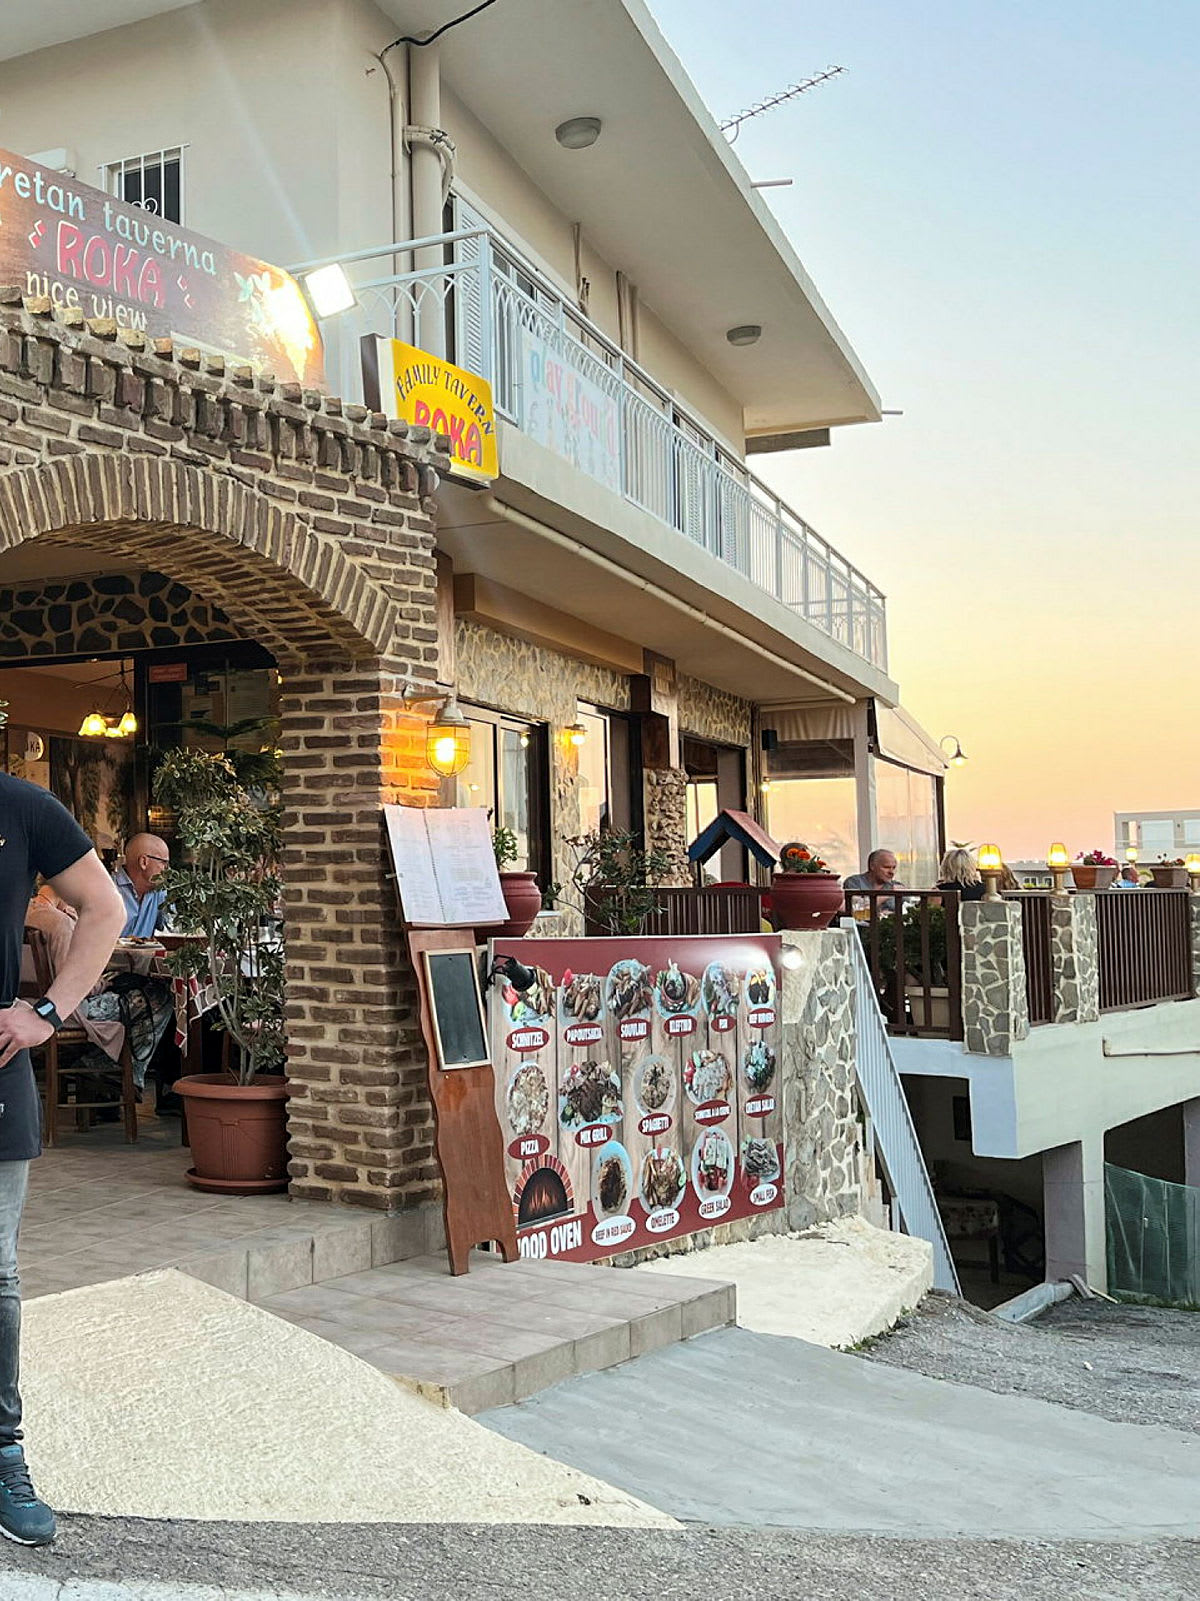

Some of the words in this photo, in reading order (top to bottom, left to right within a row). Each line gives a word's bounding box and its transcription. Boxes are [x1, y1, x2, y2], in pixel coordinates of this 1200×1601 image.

[57, 220, 165, 309] ROKA
[103, 202, 216, 276] taverna
[26, 270, 80, 309] nice
[91, 295, 148, 332] view
[396, 364, 440, 402] FAMILY
[444, 370, 494, 435] TAVERN
[520, 1139, 539, 1155] PIZZA
[550, 1220, 582, 1255] OVEN
